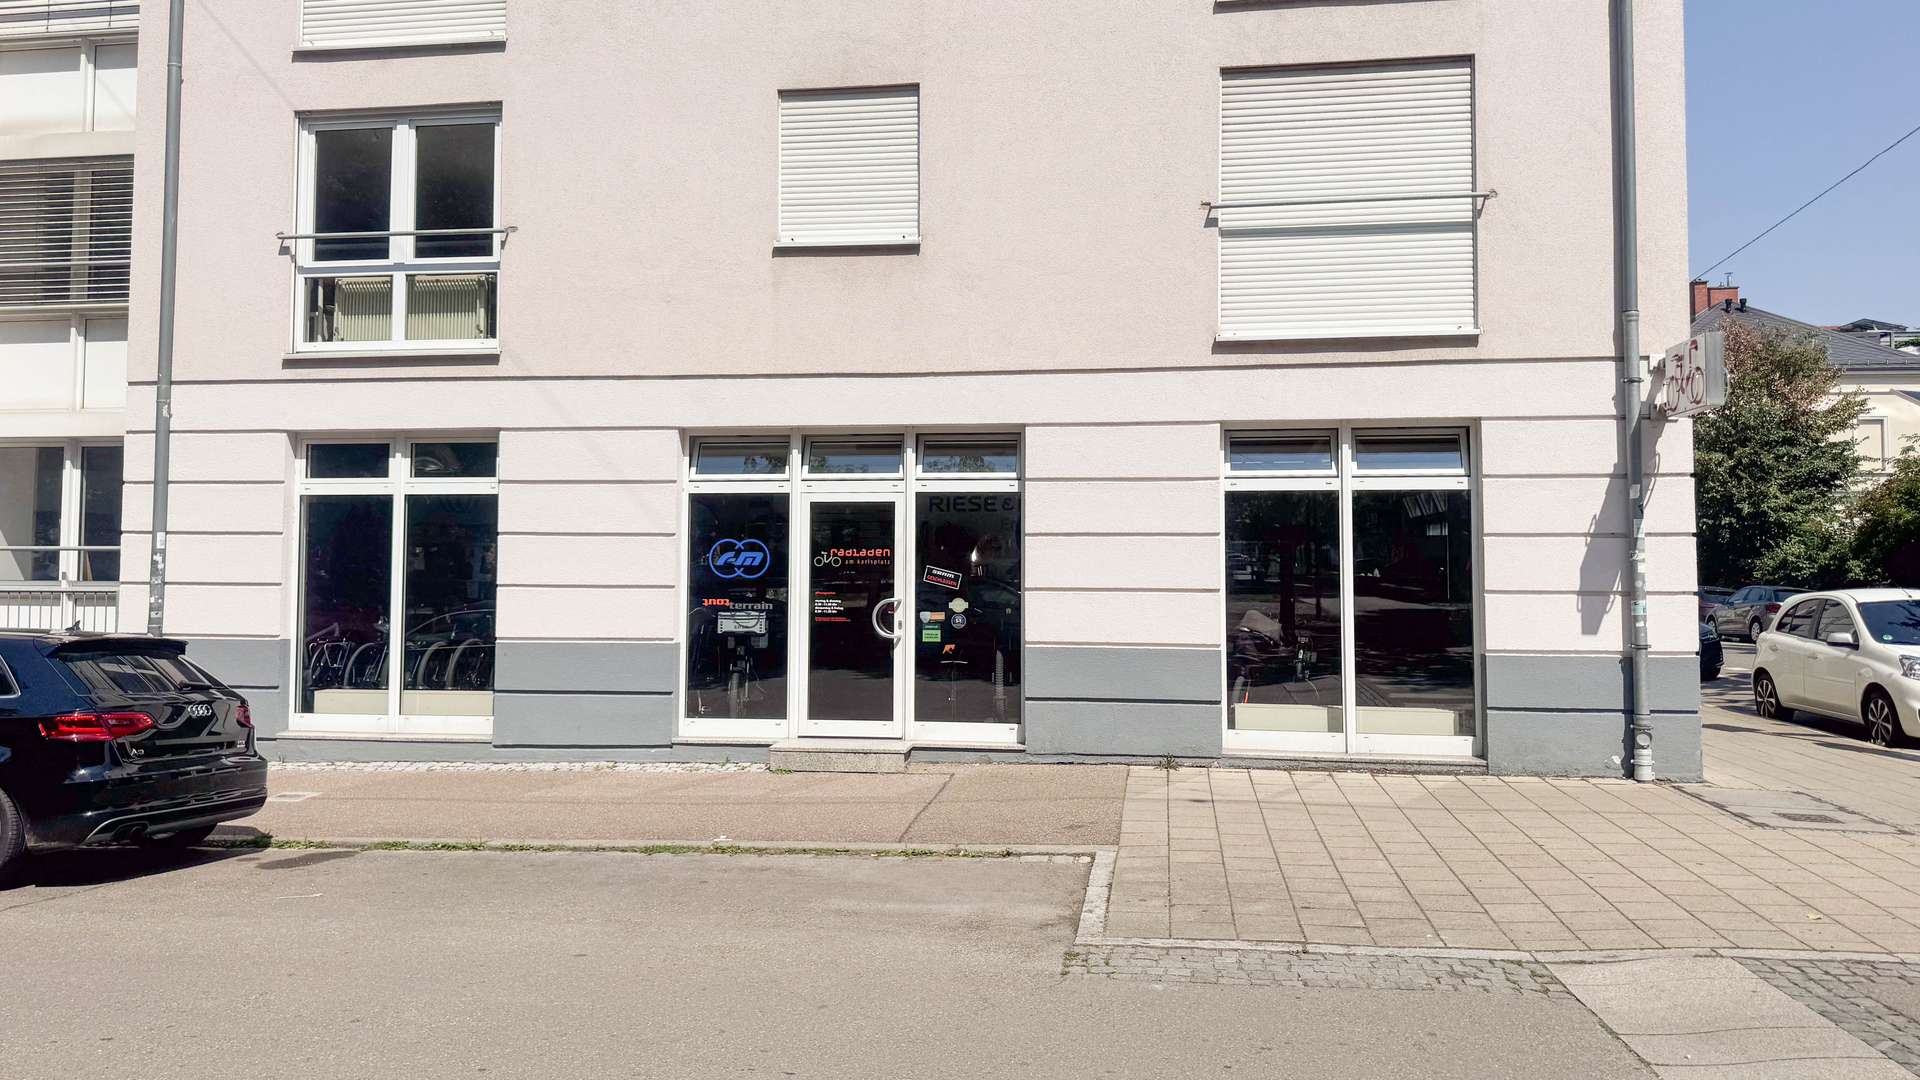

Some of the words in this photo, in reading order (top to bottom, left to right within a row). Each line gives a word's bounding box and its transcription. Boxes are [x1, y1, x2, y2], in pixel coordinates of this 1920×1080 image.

[929, 496, 998, 512] RIESE
[1002, 496, 1015, 511] &
[729, 601, 773, 610] terrain
